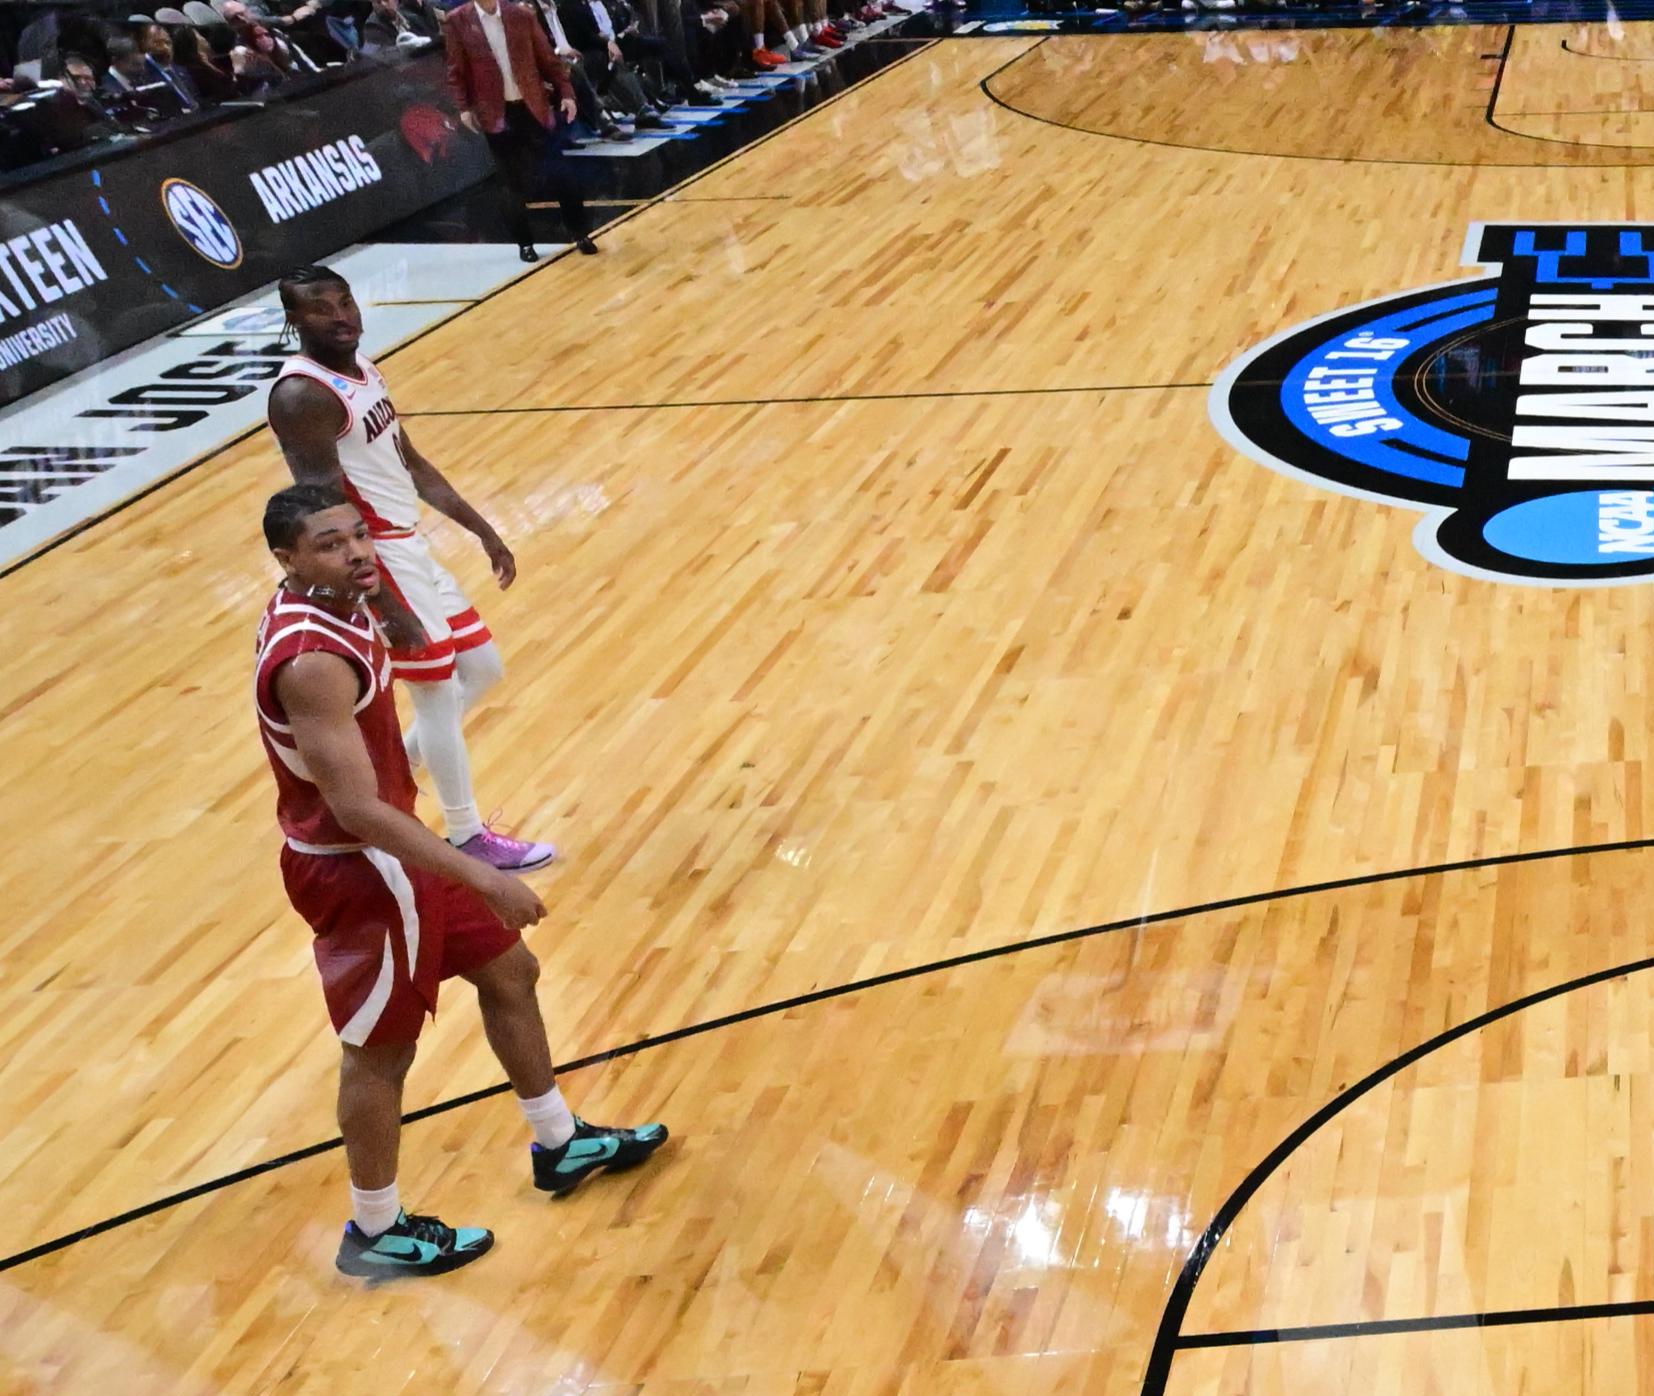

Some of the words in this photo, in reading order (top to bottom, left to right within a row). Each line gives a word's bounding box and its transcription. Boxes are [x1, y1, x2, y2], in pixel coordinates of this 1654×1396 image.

[249, 136, 382, 224] ARKANSAS
[167, 184, 238, 263] SEC
[362, 396, 396, 444] ARIZO
[1303, 366, 1404, 438] SWEET
